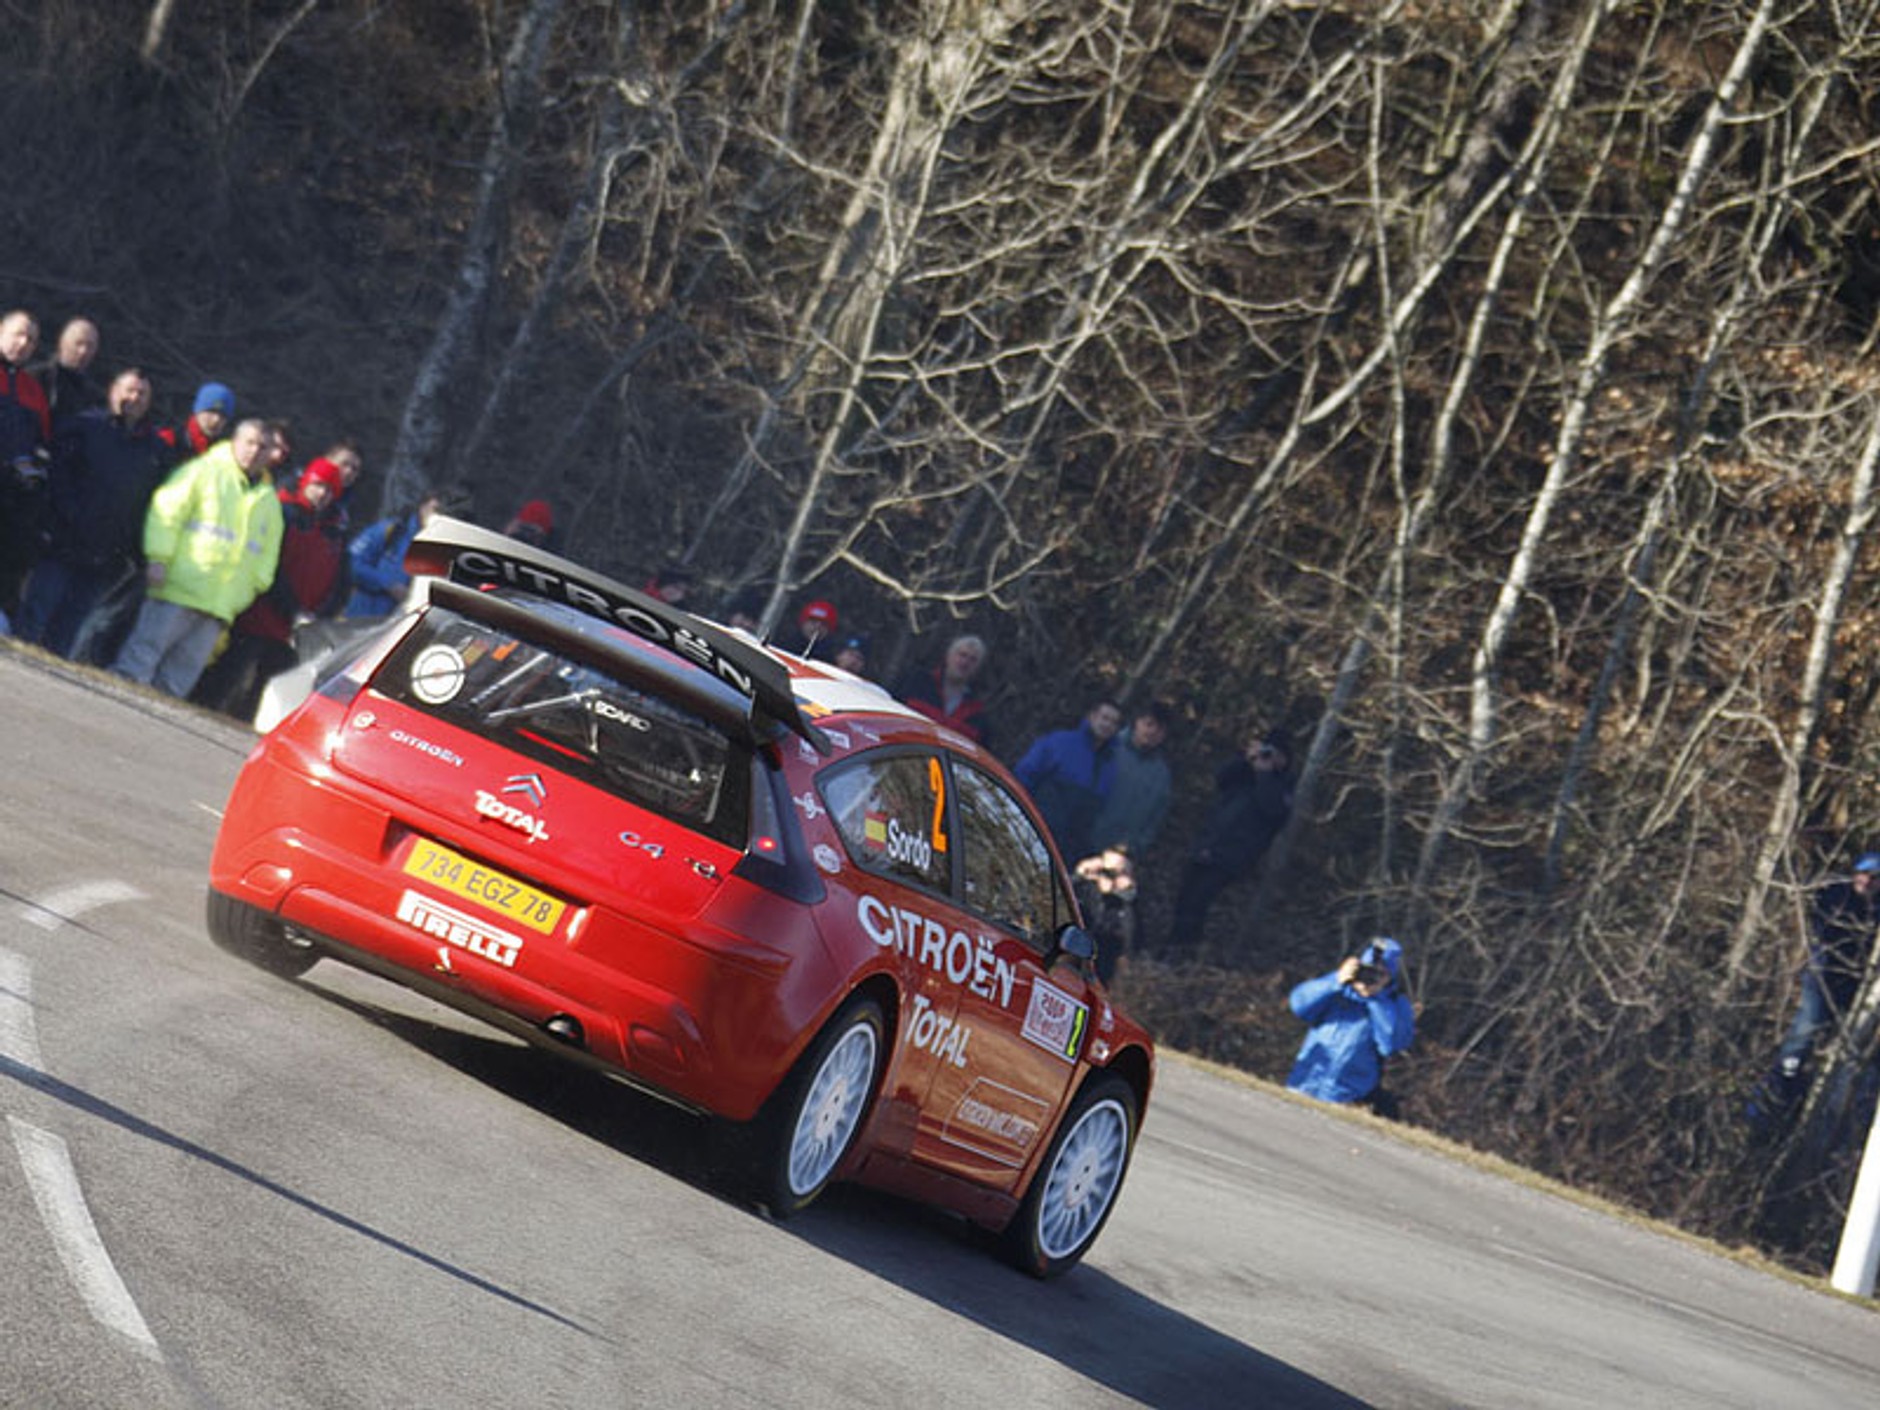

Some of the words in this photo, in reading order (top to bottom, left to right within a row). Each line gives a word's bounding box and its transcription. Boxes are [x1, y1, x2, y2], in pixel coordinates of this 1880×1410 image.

[455, 551, 753, 696] CITROËN
[474, 790, 549, 844] TOTAL
[928, 756, 947, 853] 2
[619, 831, 664, 858] C4
[888, 818, 931, 871] Sordo
[419, 850, 464, 884] 734
[465, 869, 521, 908] EGZ
[521, 894, 553, 923] 78
[396, 888, 524, 968] PIRELLI
[857, 895, 1015, 1008] CITROËN
[905, 994, 971, 1069] TOTAL
